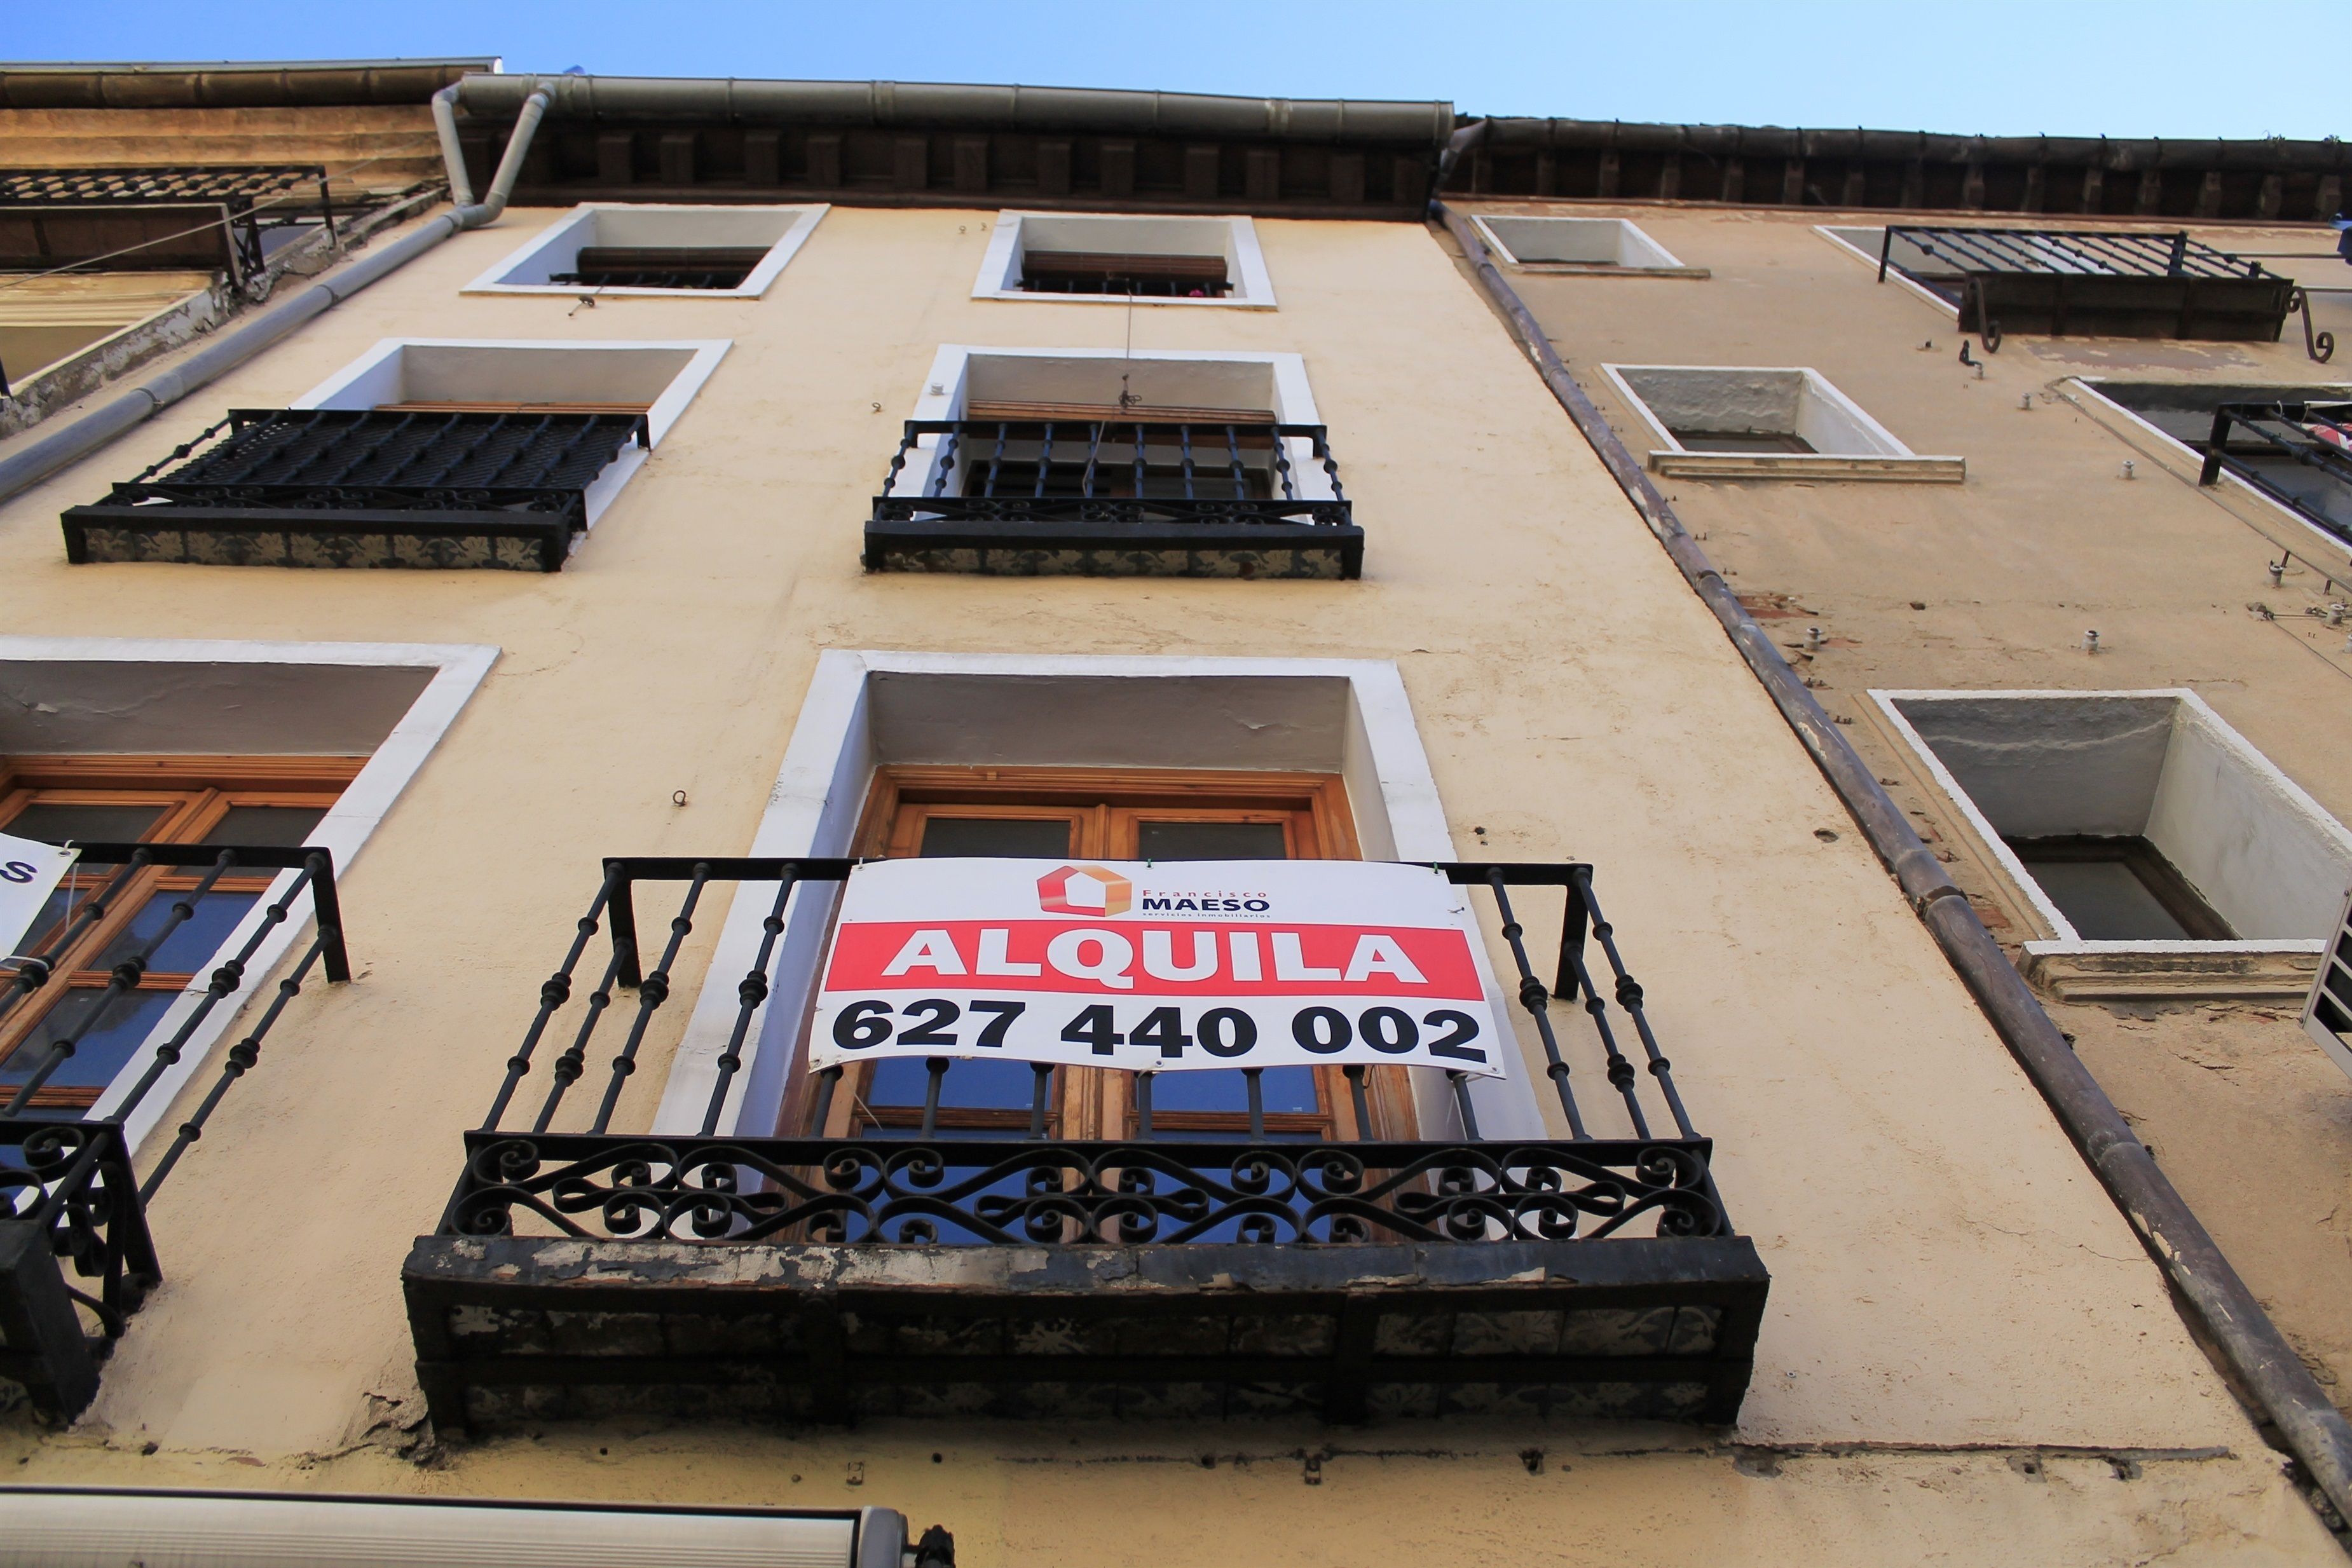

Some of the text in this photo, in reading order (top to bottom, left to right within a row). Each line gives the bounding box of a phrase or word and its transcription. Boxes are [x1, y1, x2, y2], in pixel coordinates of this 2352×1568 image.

[1142, 898, 1270, 911] MAESO
[1143, 889, 1268, 897] Francisco
[881, 929, 1429, 988] ALQUILA
[832, 1000, 1487, 1063] 627 440 002
